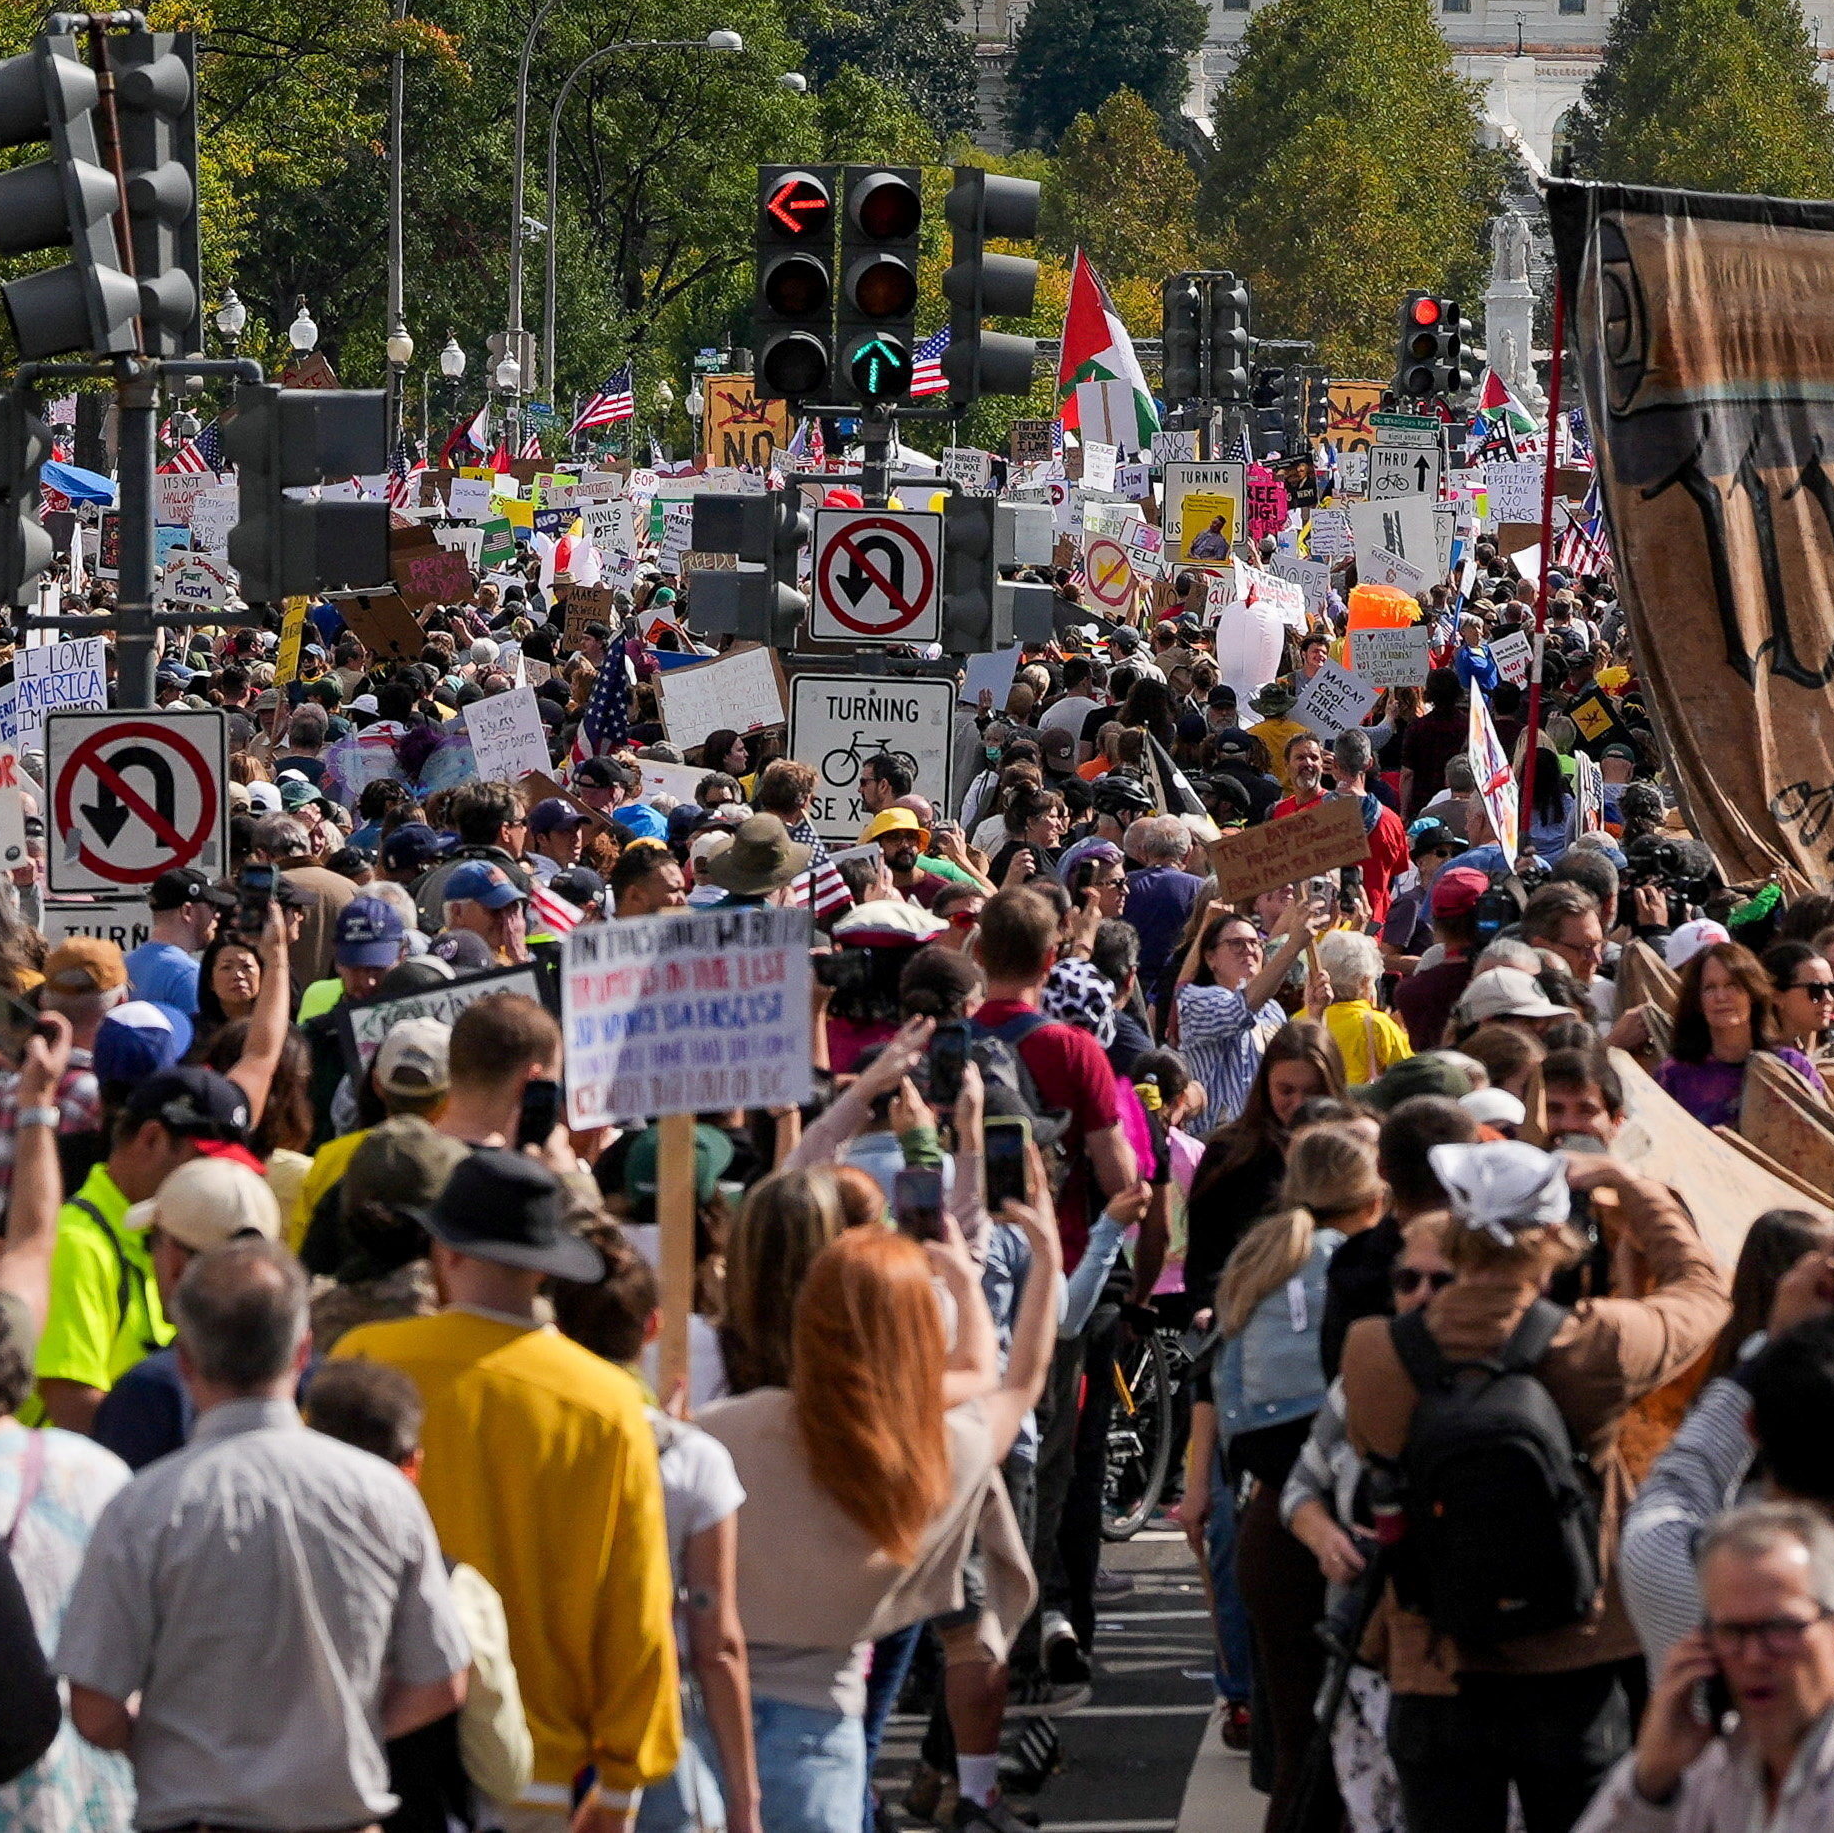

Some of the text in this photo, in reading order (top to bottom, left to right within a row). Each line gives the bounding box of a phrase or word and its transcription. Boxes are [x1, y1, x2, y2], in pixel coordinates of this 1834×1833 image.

[1162, 433, 1185, 448] NO
[1378, 452, 1408, 466] THRU
[634, 472, 654, 487] GOP
[1181, 471, 1229, 483] TURNING
[1501, 486, 1528, 495] TIME
[1499, 496, 1521, 506] NO
[535, 513, 559, 528] NO
[1489, 508, 1536, 522] KINGS
[594, 524, 620, 539] OFF
[1270, 558, 1327, 597] NOPE
[570, 590, 601, 602] MAKE
[18, 641, 99, 678] I LOVE
[1503, 659, 1522, 674] NOT
[18, 669, 104, 709] AMERICA
[1323, 670, 1365, 704] MAGA?
[826, 696, 919, 723] TURNING
[1310, 691, 1336, 713] FIRE
